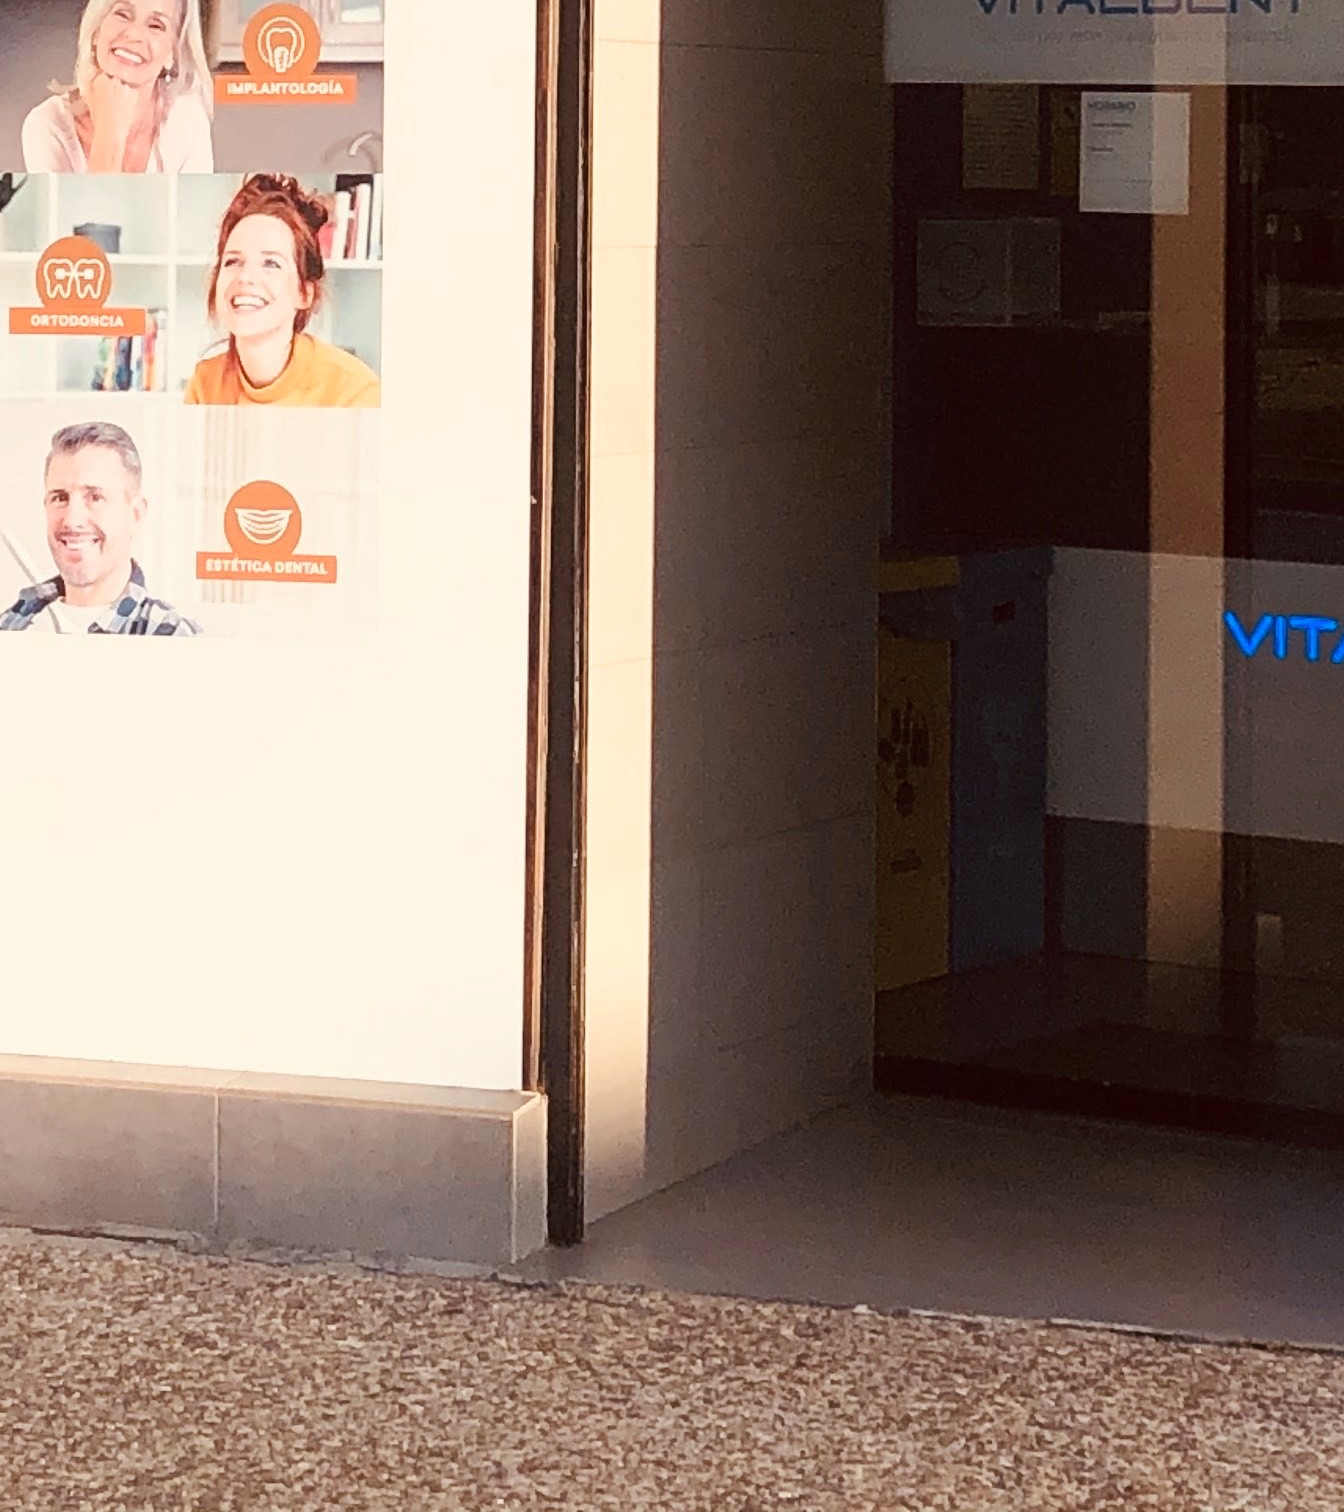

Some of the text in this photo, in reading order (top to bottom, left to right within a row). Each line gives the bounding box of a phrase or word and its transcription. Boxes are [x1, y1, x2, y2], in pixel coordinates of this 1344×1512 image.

[226, 79, 345, 96] IMPLANTOLOGÍA
[30, 314, 125, 328] ORTODONCIA
[205, 554, 329, 576] ESTÉTICA DENTAL
